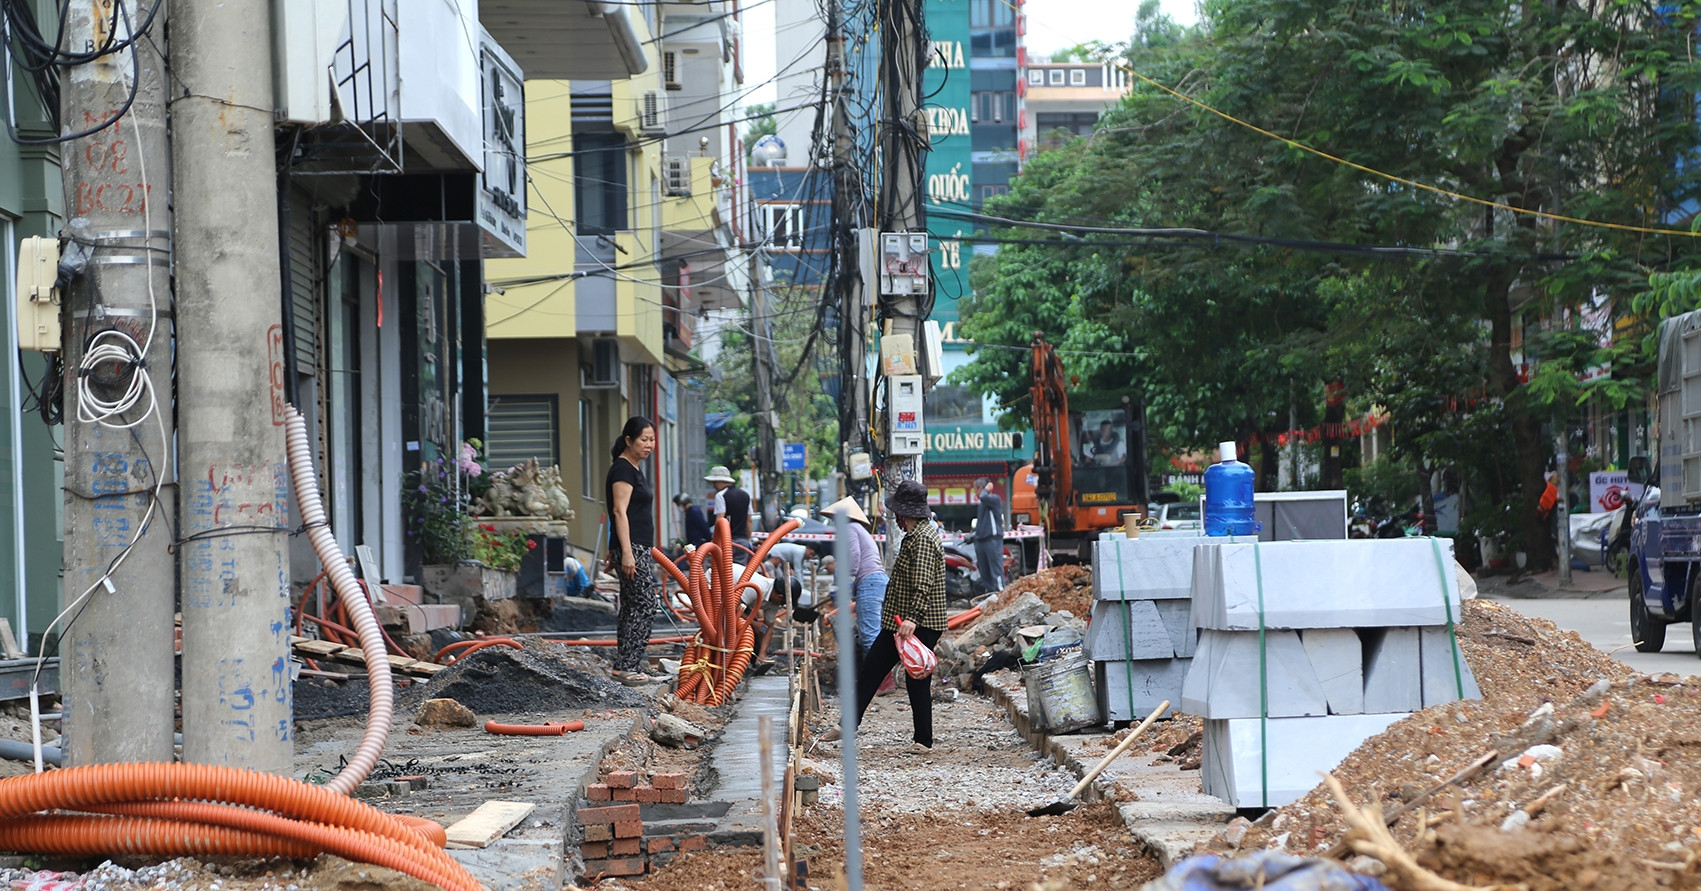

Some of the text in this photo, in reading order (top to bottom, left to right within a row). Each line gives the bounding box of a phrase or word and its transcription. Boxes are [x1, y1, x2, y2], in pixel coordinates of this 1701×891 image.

[929, 40, 966, 69] NHA
[928, 107, 970, 136] KHOA
[77, 181, 152, 215] BC27
[928, 161, 970, 204] QUỐC
[939, 229, 961, 269] TẾ
[934, 426, 985, 452] QUẢNG
